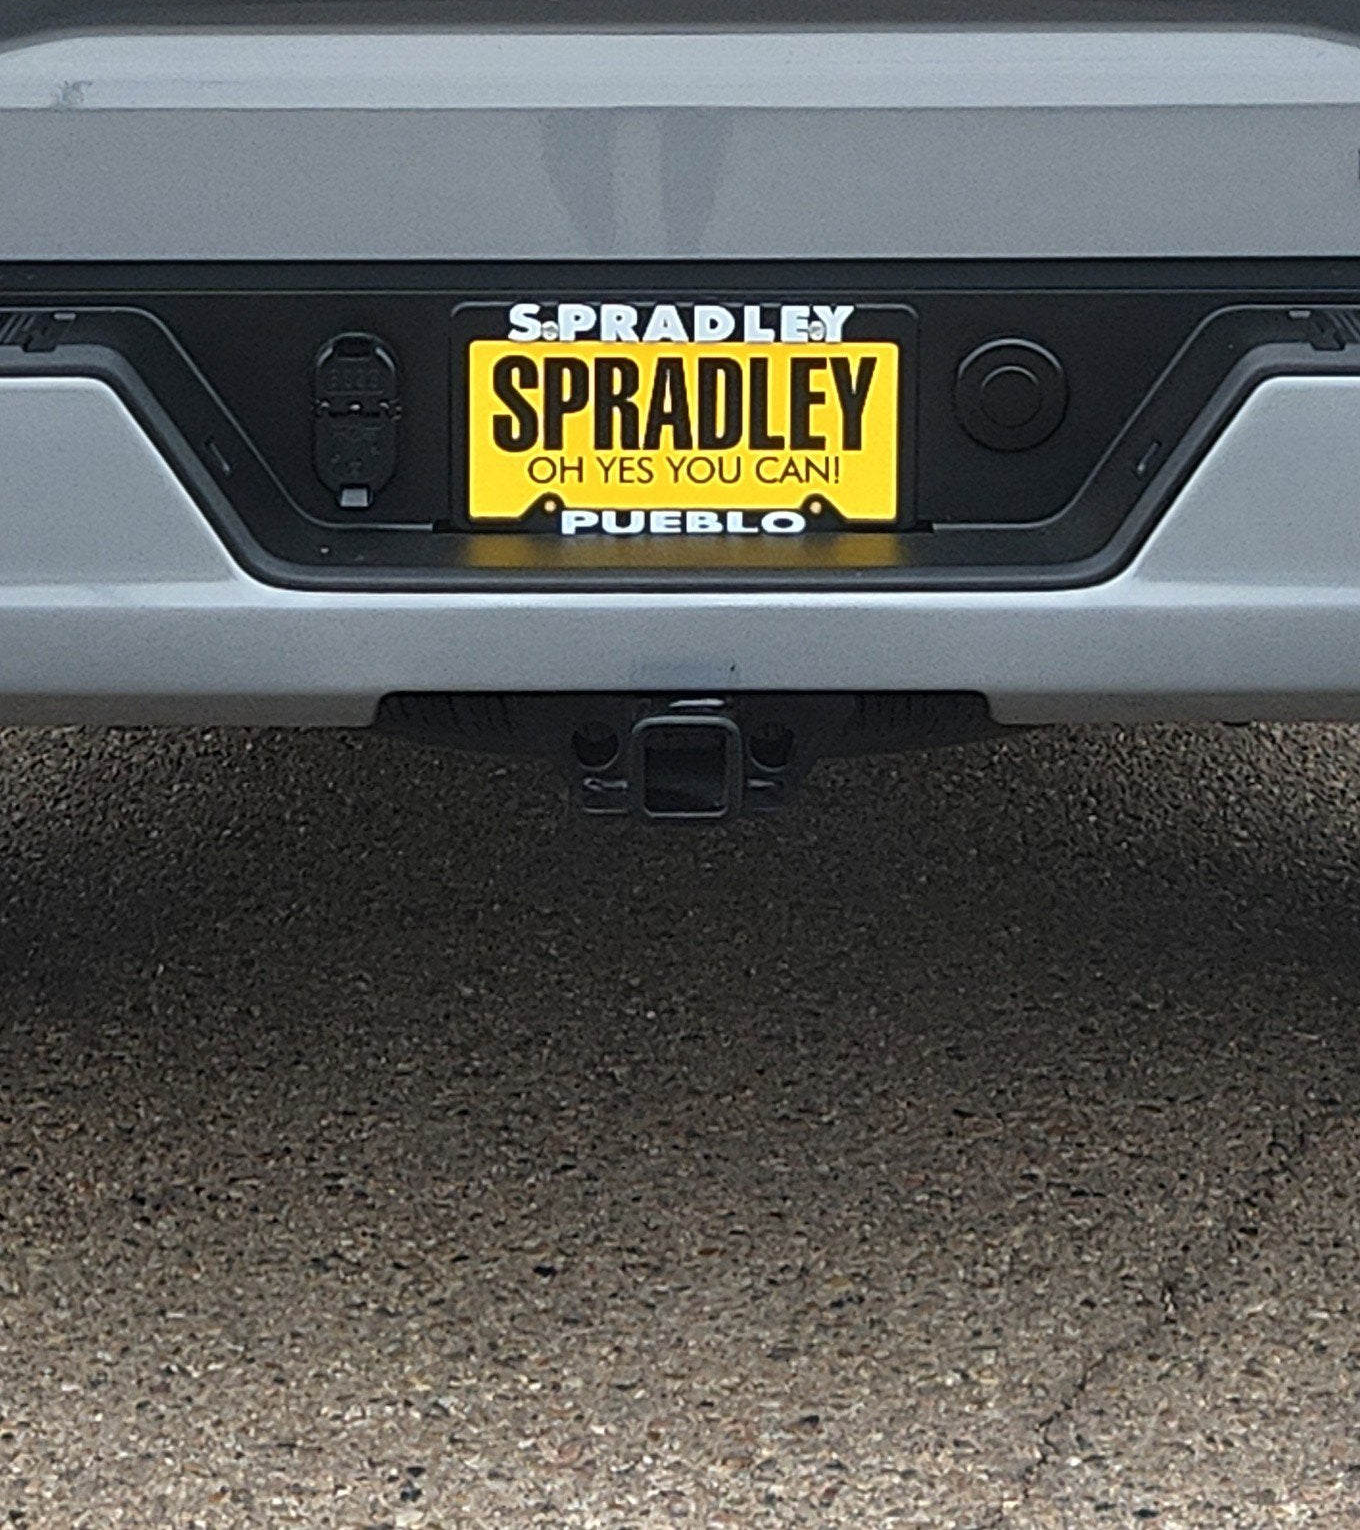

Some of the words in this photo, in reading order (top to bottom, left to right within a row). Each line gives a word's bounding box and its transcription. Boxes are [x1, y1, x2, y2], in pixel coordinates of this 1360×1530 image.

[508, 302, 855, 343] SPRADLEY
[491, 353, 878, 453] SPRADLEY
[527, 455, 584, 484] OH
[596, 455, 654, 484] YES
[667, 455, 742, 484] YOU
[755, 455, 840, 484] CAN!
[560, 509, 807, 536] PUEBLO
